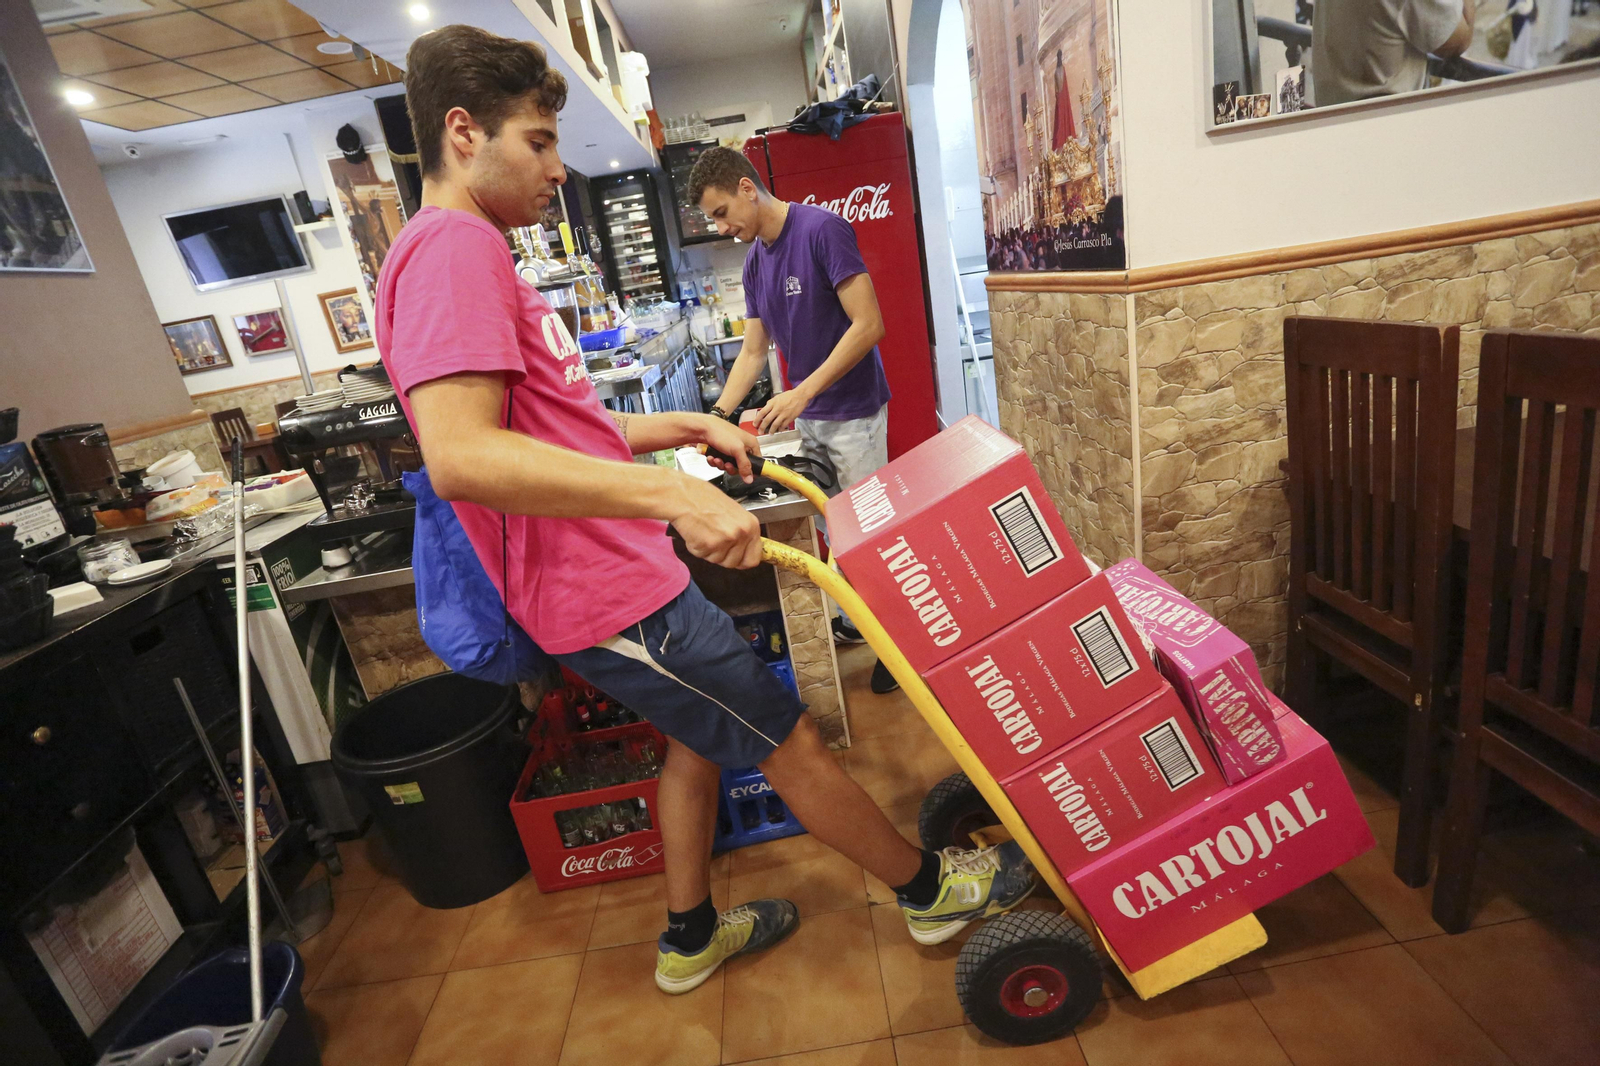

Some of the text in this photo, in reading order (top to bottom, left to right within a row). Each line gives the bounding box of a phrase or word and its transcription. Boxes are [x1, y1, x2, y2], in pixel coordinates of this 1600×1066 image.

[802, 183, 891, 223] ca-Cola
[1073, 236, 1100, 249] Carrasco
[1101, 233, 1112, 246] Pla
[359, 402, 398, 420] GAGGIA
[849, 475, 896, 533] CARTOJAL
[272, 561, 290, 577] 100%
[879, 535, 962, 647] CARTOJAL
[1172, 650, 1196, 671] VASITOS
[967, 654, 1043, 755] CARTOJAL
[1199, 668, 1281, 766] CARTOJAL
[1040, 762, 1112, 852] CARTOJAL
[561, 846, 634, 877] Coca-Cola
[1112, 787, 1327, 919] CARTOJAL
[1190, 862, 1283, 913] MÁLAGA
